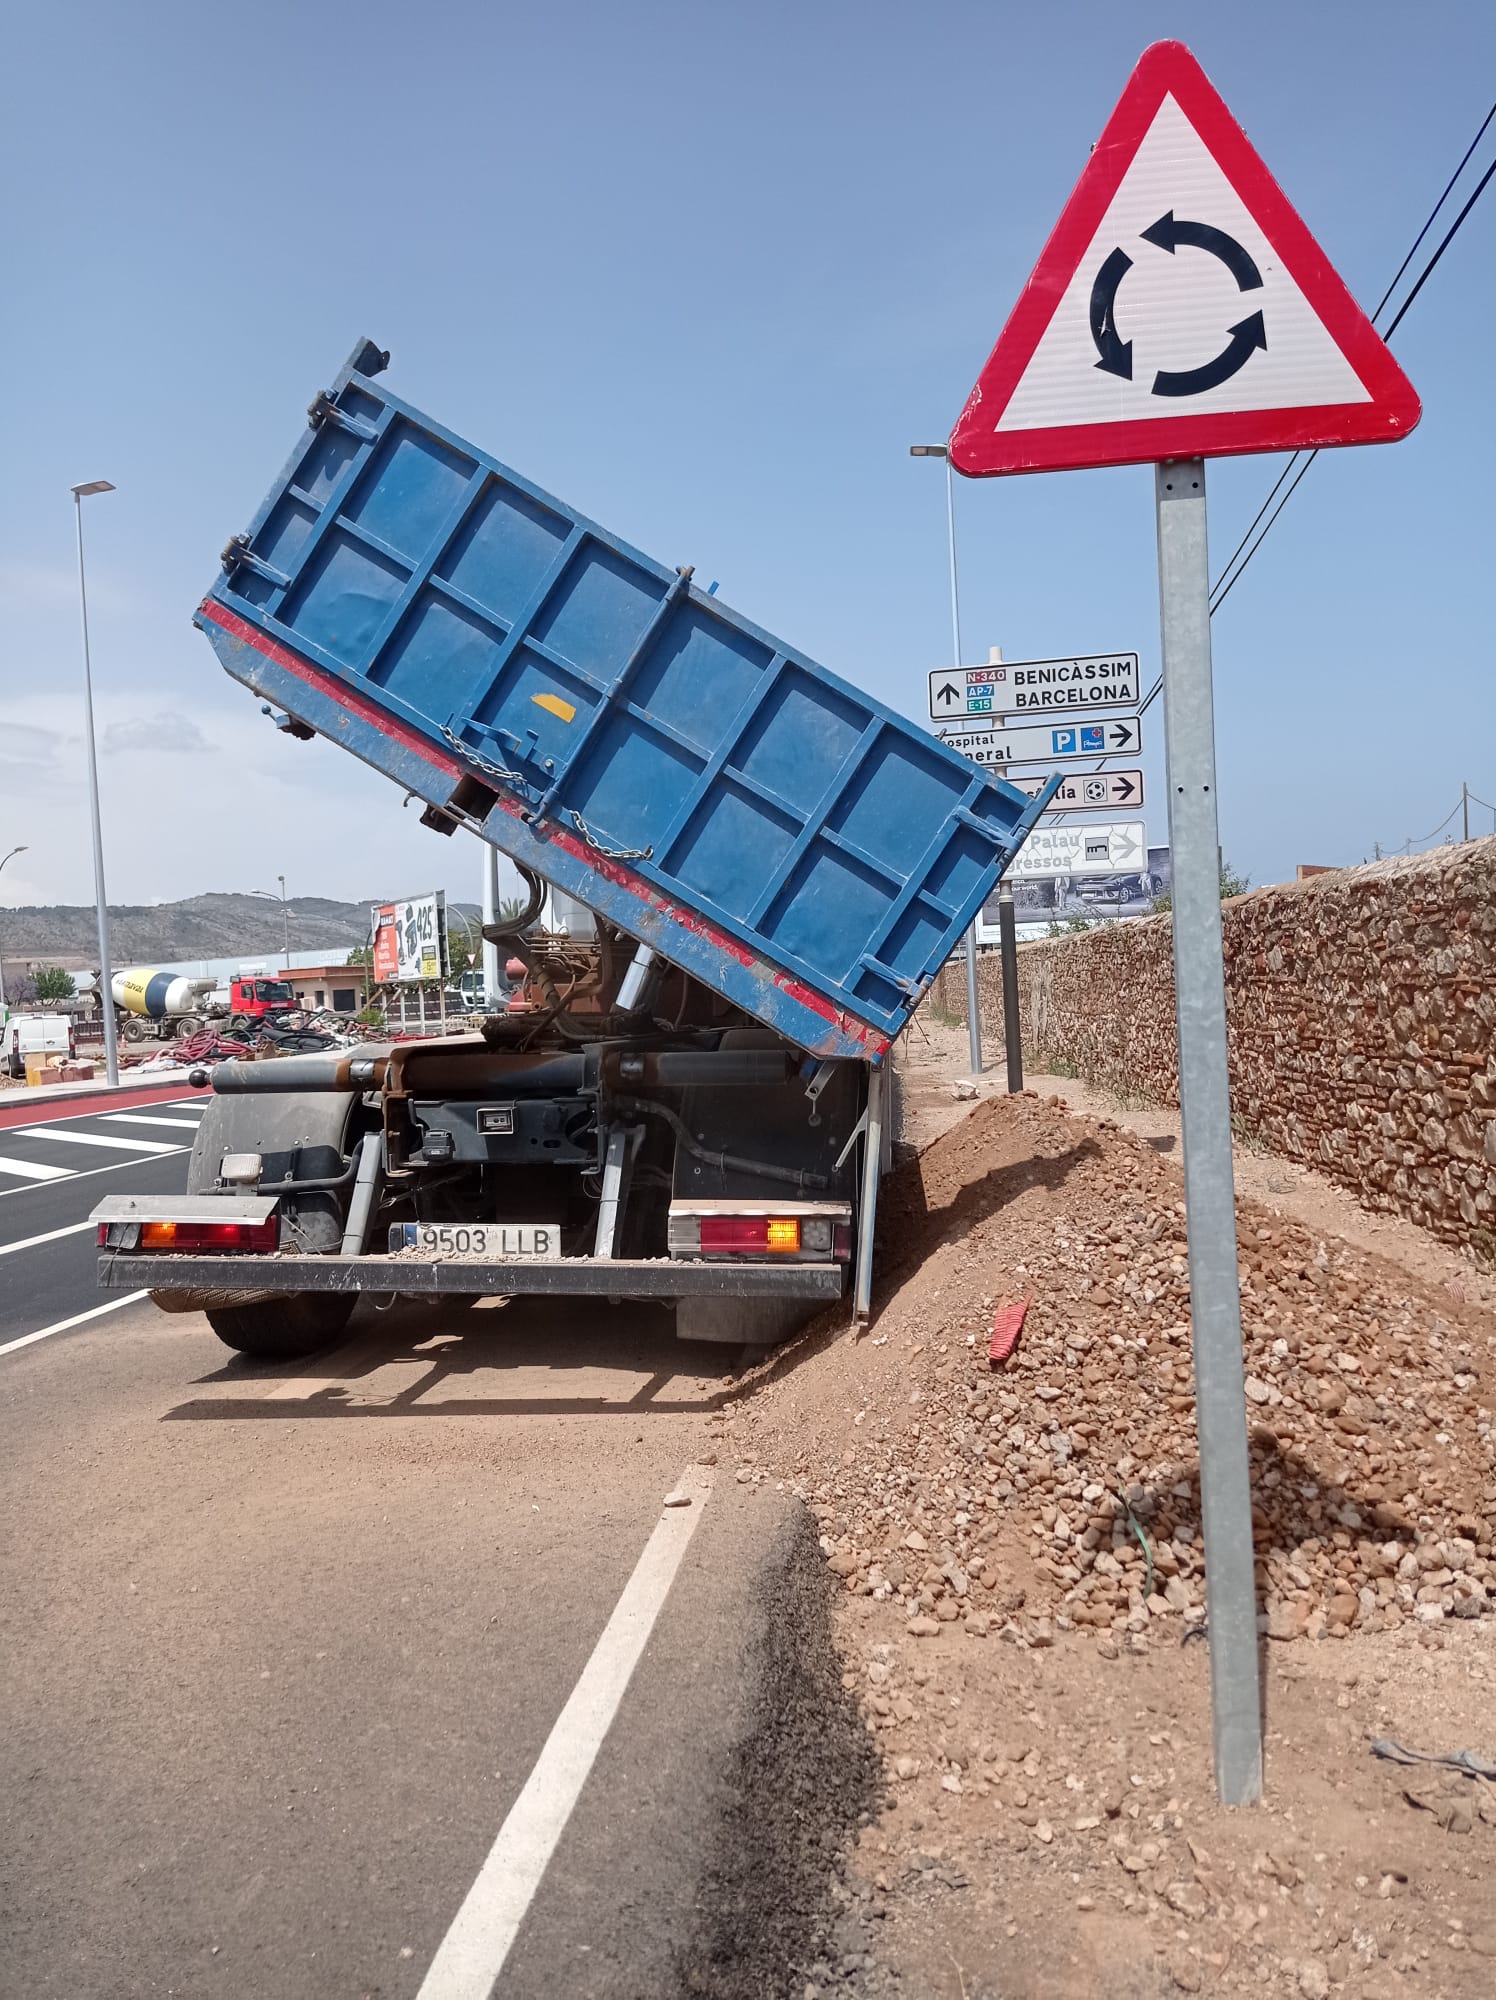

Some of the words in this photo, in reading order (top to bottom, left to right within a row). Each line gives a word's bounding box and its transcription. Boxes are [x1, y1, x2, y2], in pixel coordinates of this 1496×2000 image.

[967, 670, 1005, 683] N-340
[1014, 661, 1131, 686] BENICÀSSIM
[968, 685, 993, 697] AP-7
[1016, 683, 1132, 708] BARCELONA
[967, 699, 991, 711] E-15
[944, 733, 995, 748] ospital
[965, 745, 1012, 761] neral
[1030, 834, 1080, 850] Palau
[1007, 855, 1073, 873] gressos
[423, 1229, 487, 1253] 9503
[502, 1229, 550, 1254] LLB
